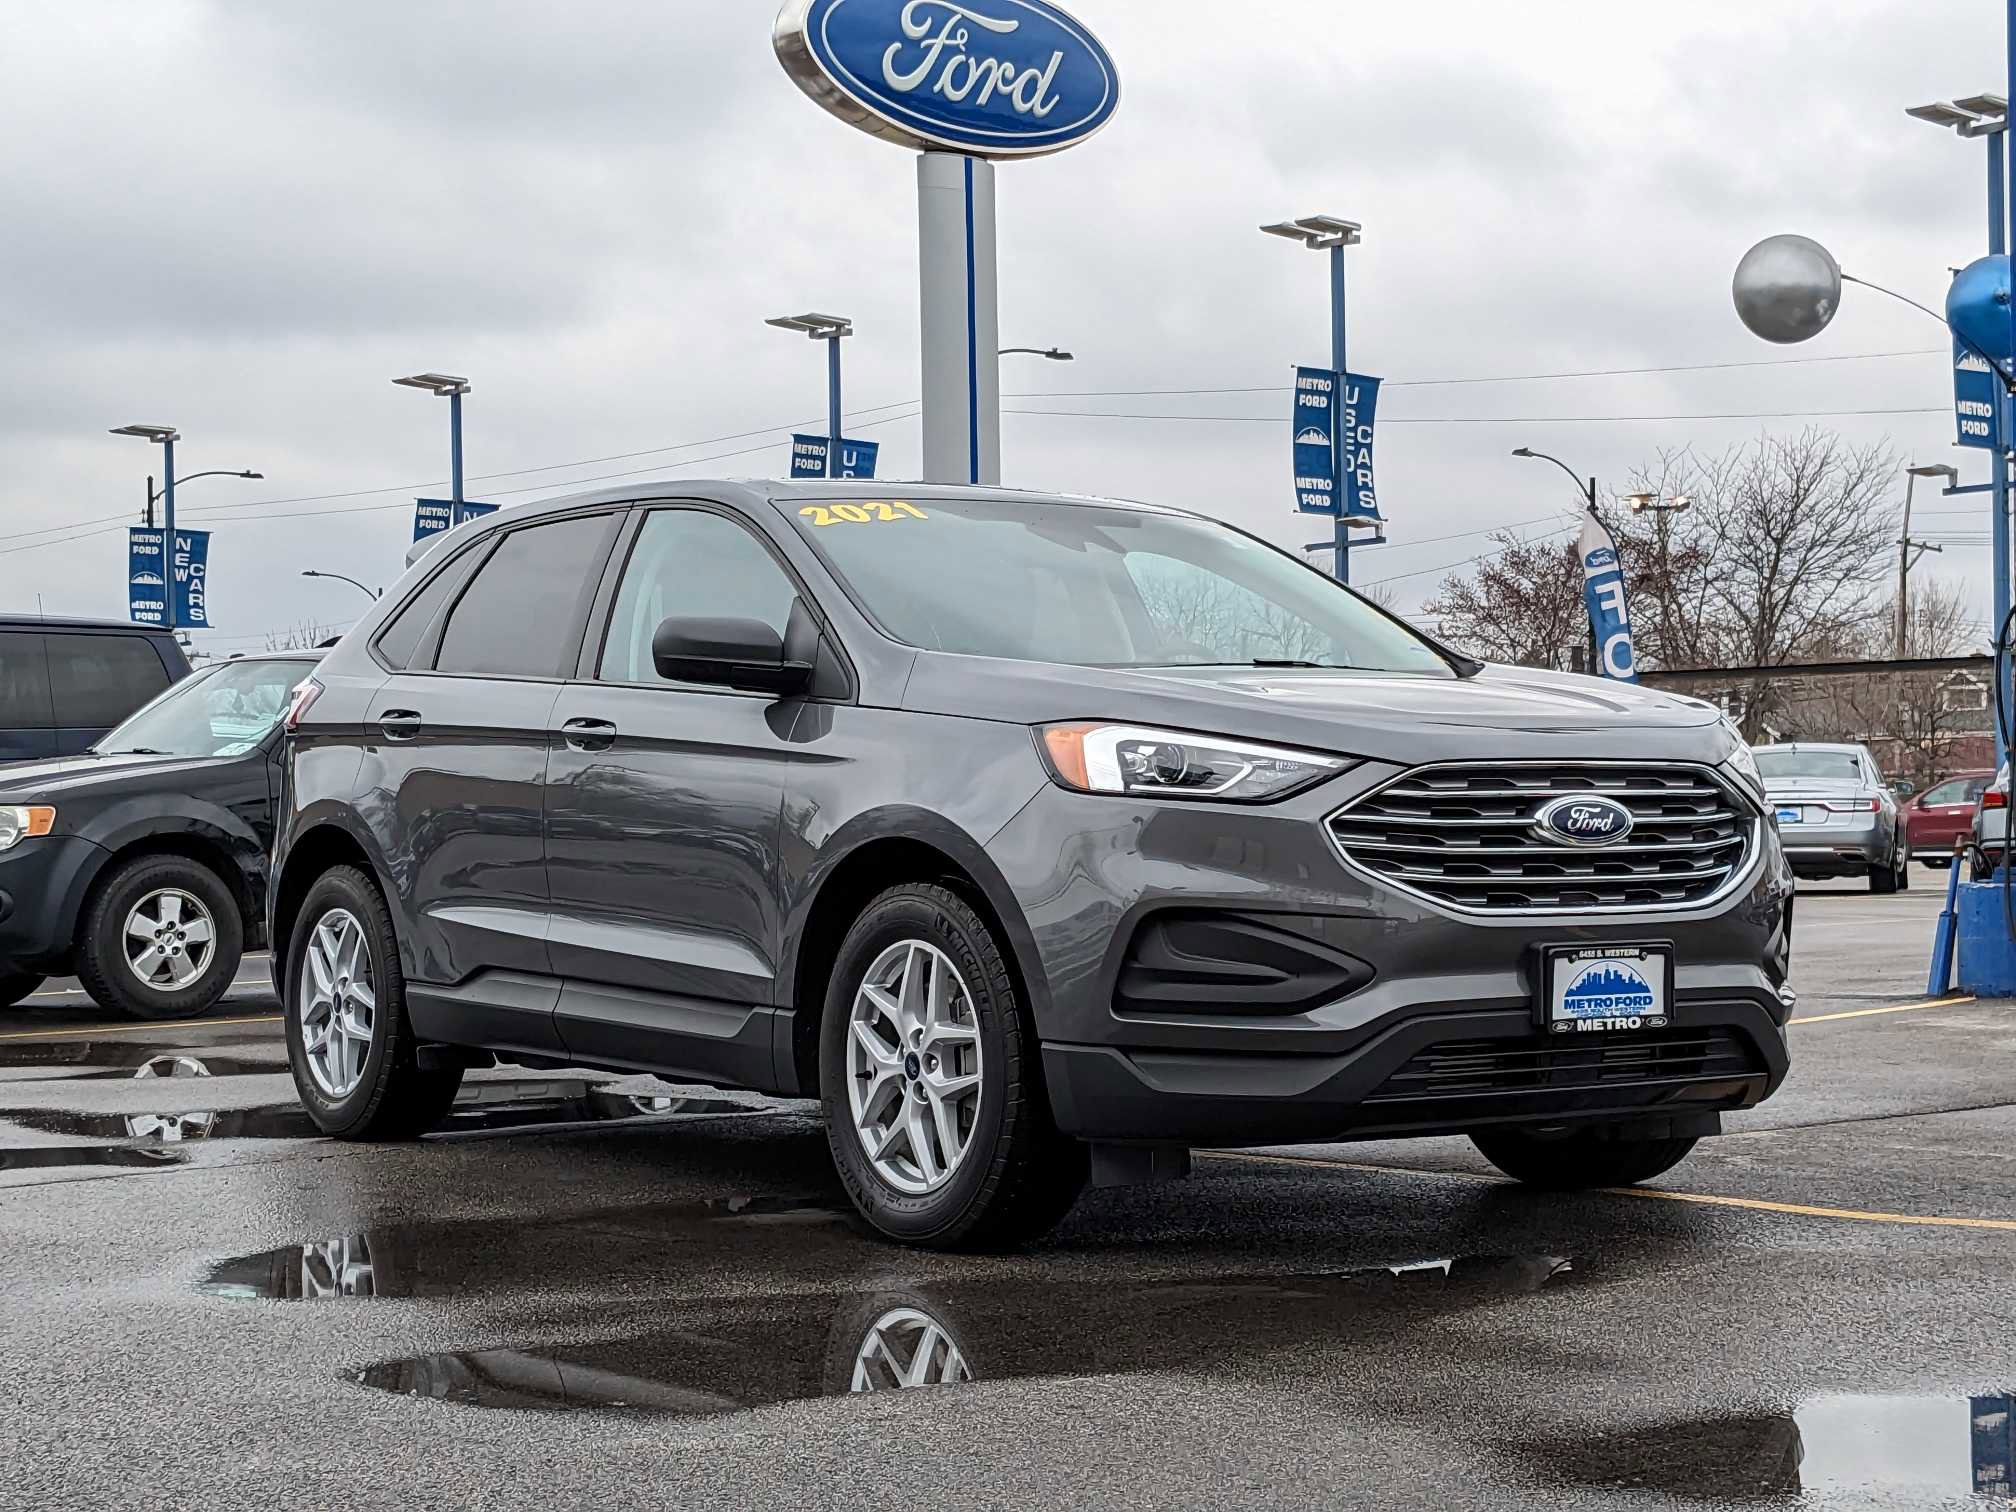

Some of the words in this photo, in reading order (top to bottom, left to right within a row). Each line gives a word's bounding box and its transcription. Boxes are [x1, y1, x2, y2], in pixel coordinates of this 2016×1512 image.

[882, 0, 1064, 119] Ford
[1297, 376, 1332, 392] METRO
[1299, 394, 1328, 409] FORD
[1957, 400, 1993, 418] METRO
[1961, 419, 1990, 436] FORD
[793, 443, 826, 457] METRO
[794, 457, 822, 471] FORD
[1357, 425, 1375, 508] CARS
[1296, 477, 1333, 491] METRO
[1302, 494, 1331, 507] FORD
[417, 506, 450, 517] METRO
[798, 501, 929, 526] 2021
[419, 519, 446, 529] FORD
[131, 534, 162, 544] METRO
[132, 545, 160, 555] FORD
[175, 537, 191, 582] NEW
[188, 563, 205, 621] CARS
[131, 600, 164, 610] METRO
[134, 611, 162, 621] FORD
[1567, 806, 1614, 832] Ford
[1564, 997, 1613, 1010] METRO
[1615, 995, 1653, 1006] FORD
